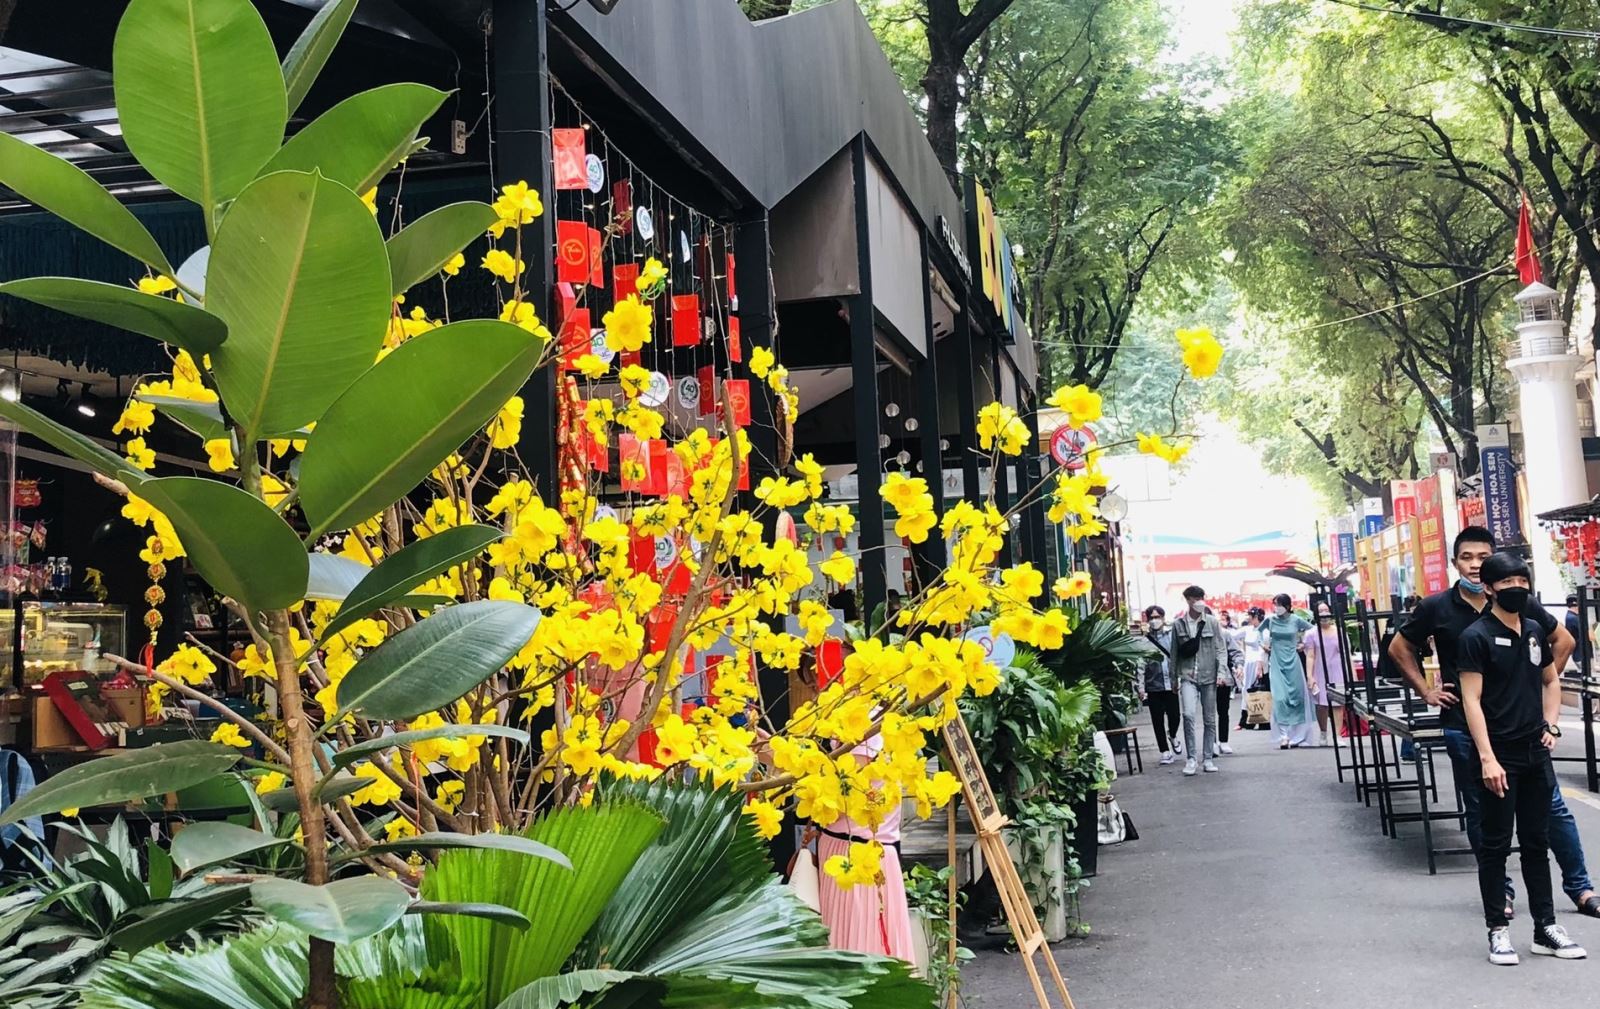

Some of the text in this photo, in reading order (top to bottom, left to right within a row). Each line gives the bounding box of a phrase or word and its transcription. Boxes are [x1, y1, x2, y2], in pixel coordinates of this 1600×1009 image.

[685, 384, 695, 393] 40
[1488, 452, 1496, 471] SEN
[1489, 473, 1499, 495] HOA
[1497, 452, 1509, 500] UNIVERSITY
[1491, 497, 1502, 519] HỌC
[1501, 501, 1510, 518] SEN
